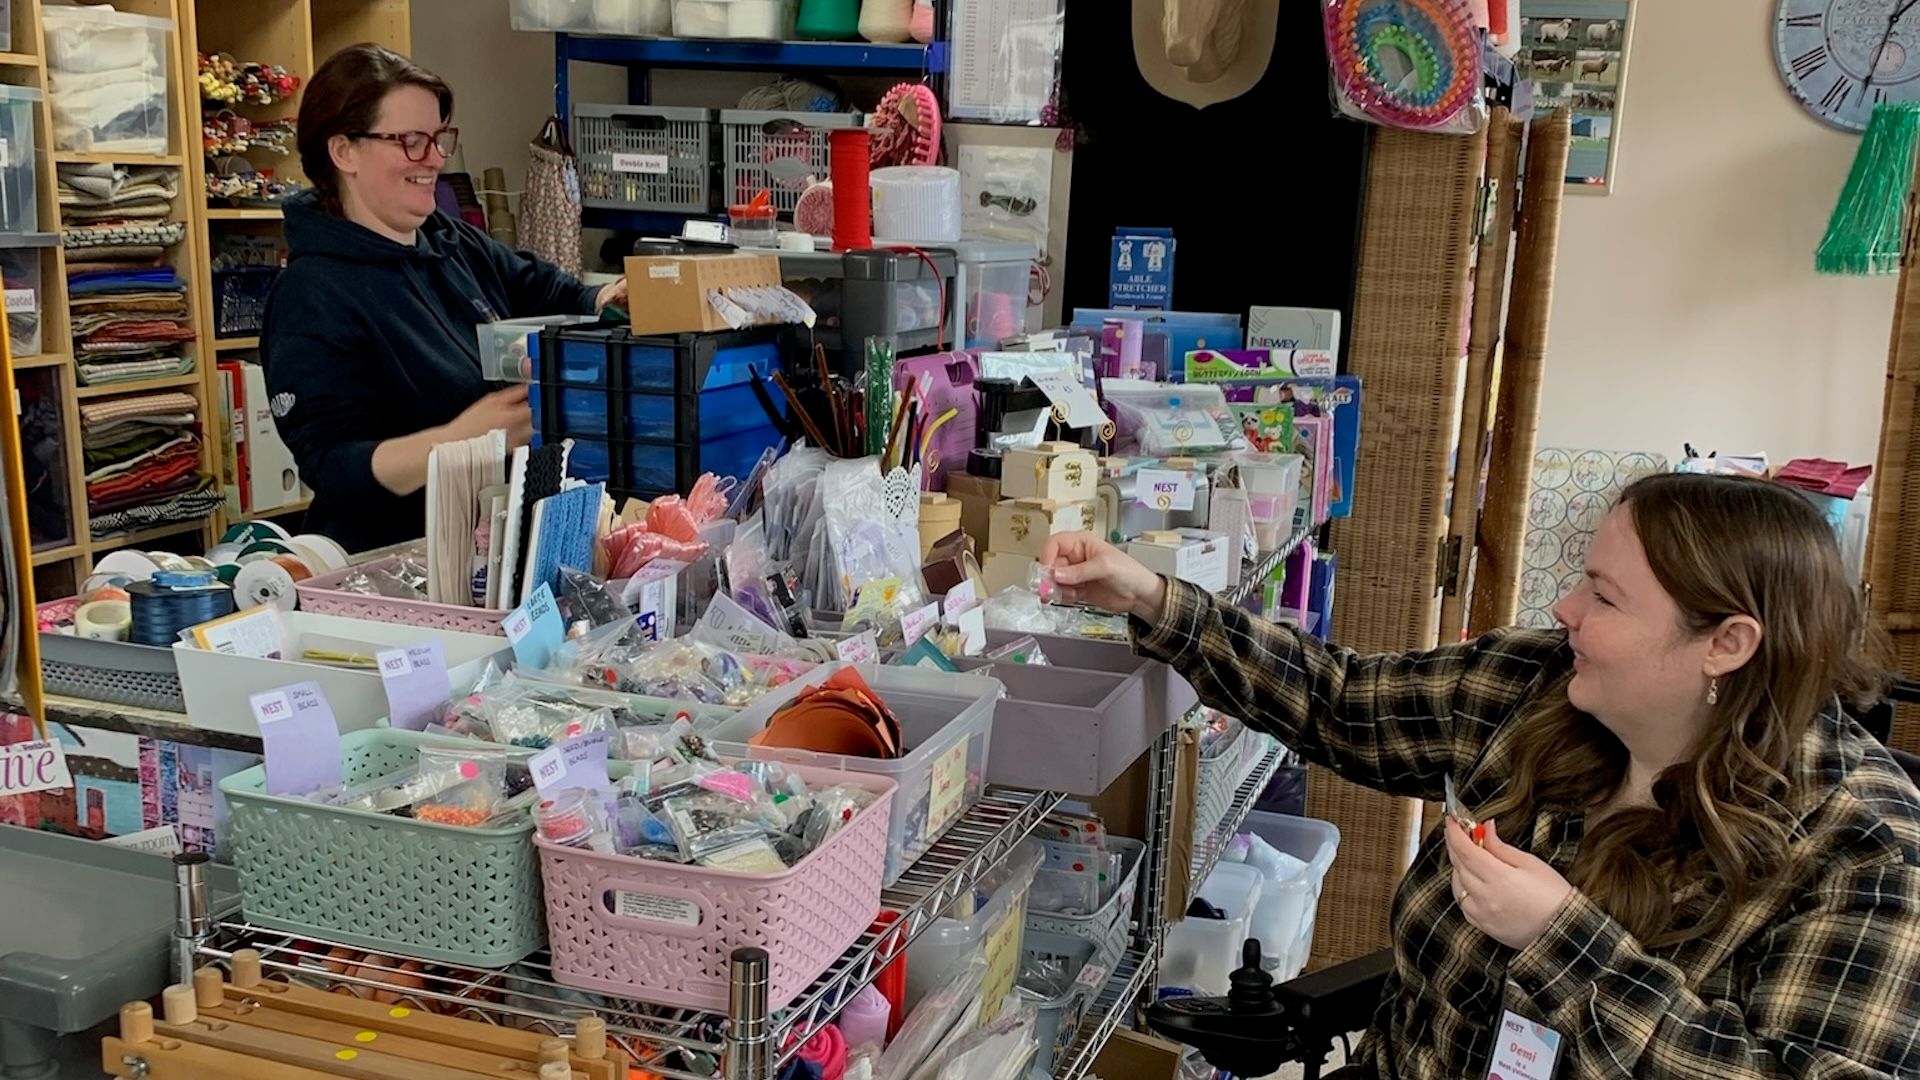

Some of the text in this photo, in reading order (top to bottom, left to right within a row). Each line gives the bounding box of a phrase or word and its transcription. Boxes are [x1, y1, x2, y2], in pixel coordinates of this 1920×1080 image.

[1791, 45, 1828, 81] VIII
[620, 160, 644, 168] Double
[1127, 275, 1153, 283] ABLE
[1111, 283, 1167, 294] STRETCHER
[1250, 336, 1300, 348] NEWEY
[1153, 482, 1179, 493] NEST
[512, 617, 528, 635] NEST
[384, 657, 404, 672] NEST
[261, 700, 284, 716] NEST
[0, 746, 57, 790] ive
[539, 759, 559, 777] NEST
[1505, 1020, 1525, 1034] NEST
[1510, 1042, 1537, 1063] Demi
